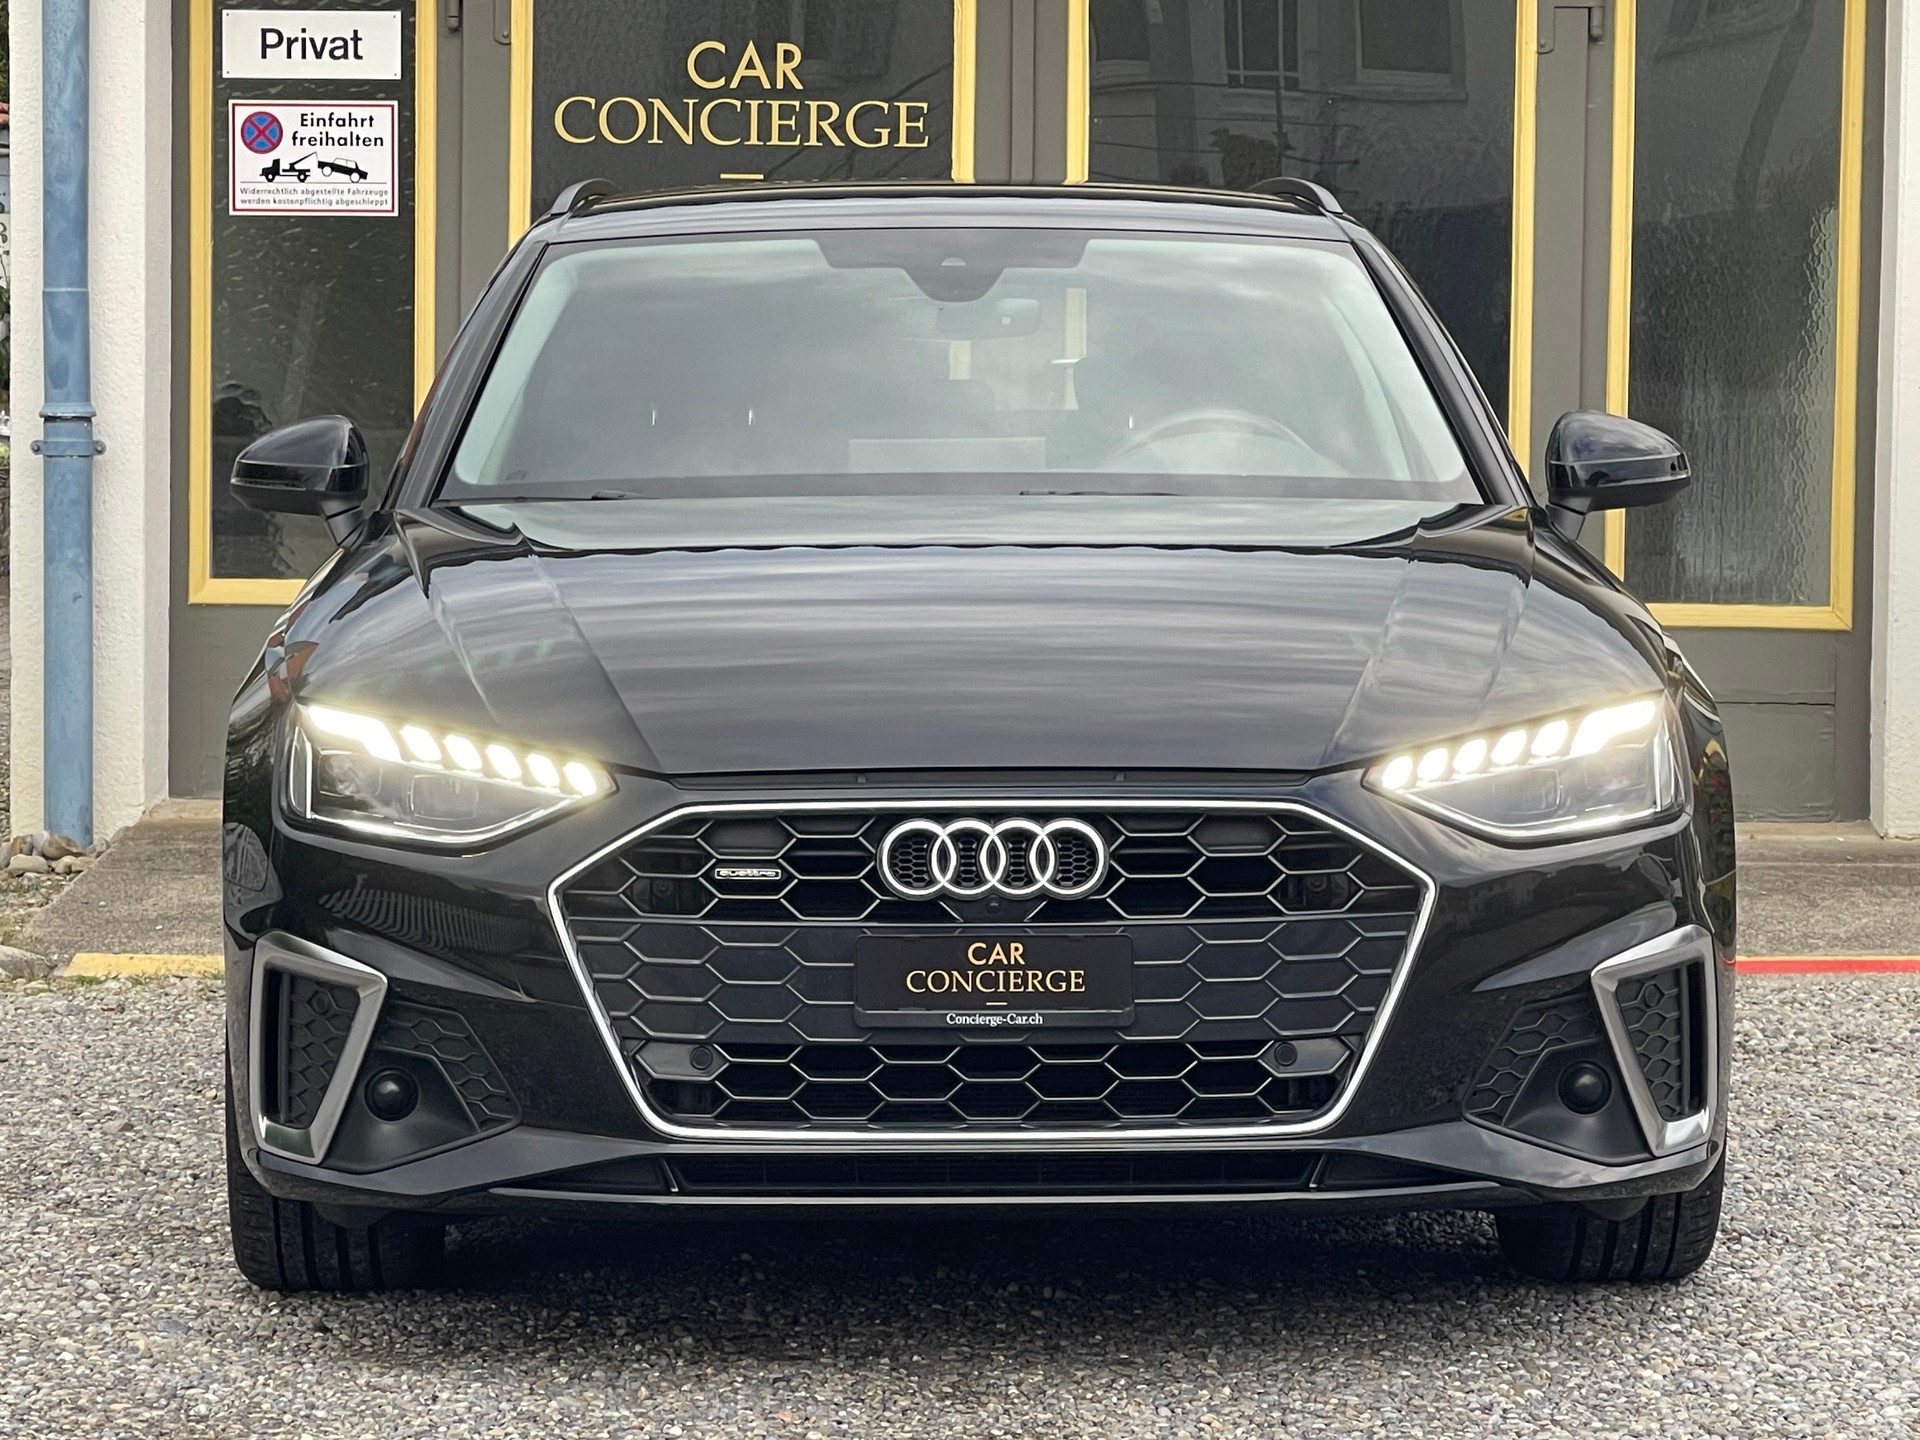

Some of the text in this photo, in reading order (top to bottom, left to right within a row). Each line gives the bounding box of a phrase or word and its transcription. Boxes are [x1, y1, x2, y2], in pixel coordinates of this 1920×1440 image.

[260, 28, 363, 60] Privat
[687, 40, 803, 90] CAR
[300, 112, 374, 128] Einfahrt
[554, 96, 929, 148] CONCIERGE
[291, 131, 384, 147] freihalten
[240, 187, 388, 197] Widerrechtlich abgestellte Fahrzeuge
[273, 198, 333, 207] kostenpflichtig
[335, 198, 388, 207] abgeschleppt
[967, 942, 1025, 965] CAR
[906, 970, 1086, 993] CONCIERGE
[946, 1013, 1043, 1027] Concierge-Car.ch
